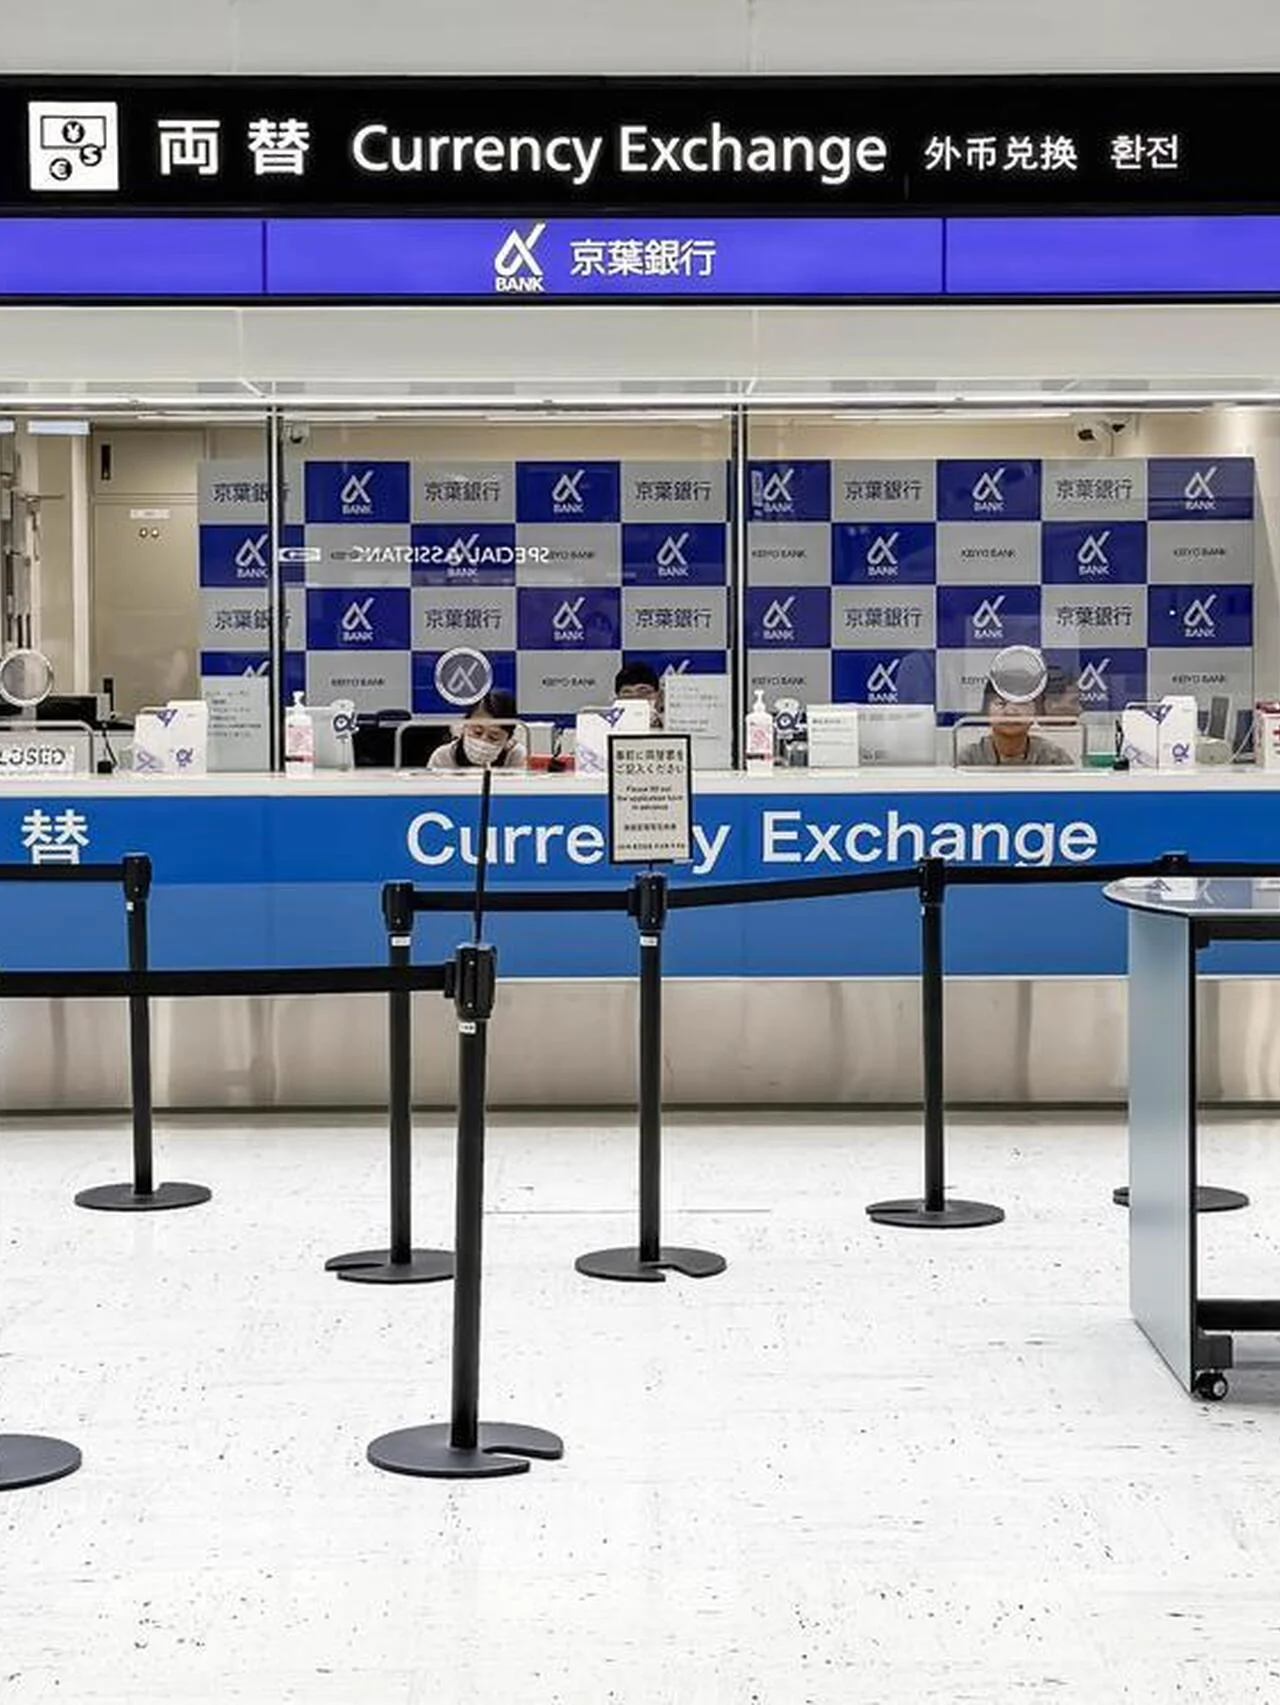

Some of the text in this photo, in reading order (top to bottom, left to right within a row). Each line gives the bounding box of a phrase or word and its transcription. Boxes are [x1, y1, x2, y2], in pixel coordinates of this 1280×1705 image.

[352, 122, 887, 185] Currency Exchange
[924, 135, 1078, 171] 外币兑换
[1110, 134, 1180, 171] 환전
[570, 238, 716, 277] 京葉銀行
[495, 277, 544, 292] BANK
[424, 481, 501, 502] 京葉銀行
[635, 481, 712, 501] 京葉銀行
[845, 480, 922, 501] 京葉銀行
[1056, 479, 1133, 500] 京葉銀行
[342, 504, 374, 515] BANK
[553, 503, 584, 513] BANK
[763, 502, 794, 512] BANK
[974, 501, 1004, 511] BANK
[1185, 500, 1216, 510] BANK
[657, 567, 689, 577] BANK
[867, 566, 899, 576] BANK
[1078, 565, 1110, 575] BANK
[425, 608, 502, 629] 京葉銀行
[635, 608, 712, 628] 京葉銀行
[845, 607, 922, 628] 京葉銀行
[1056, 606, 1133, 626] 京葉銀行
[343, 631, 374, 641] BANK
[553, 630, 584, 640] BANK
[763, 630, 795, 640] BANK
[974, 629, 1004, 638] BANK
[1185, 628, 1216, 638] BANK
[868, 693, 899, 703] BANK
[407, 811, 732, 874] Currey
[763, 811, 1098, 867] Exchange
